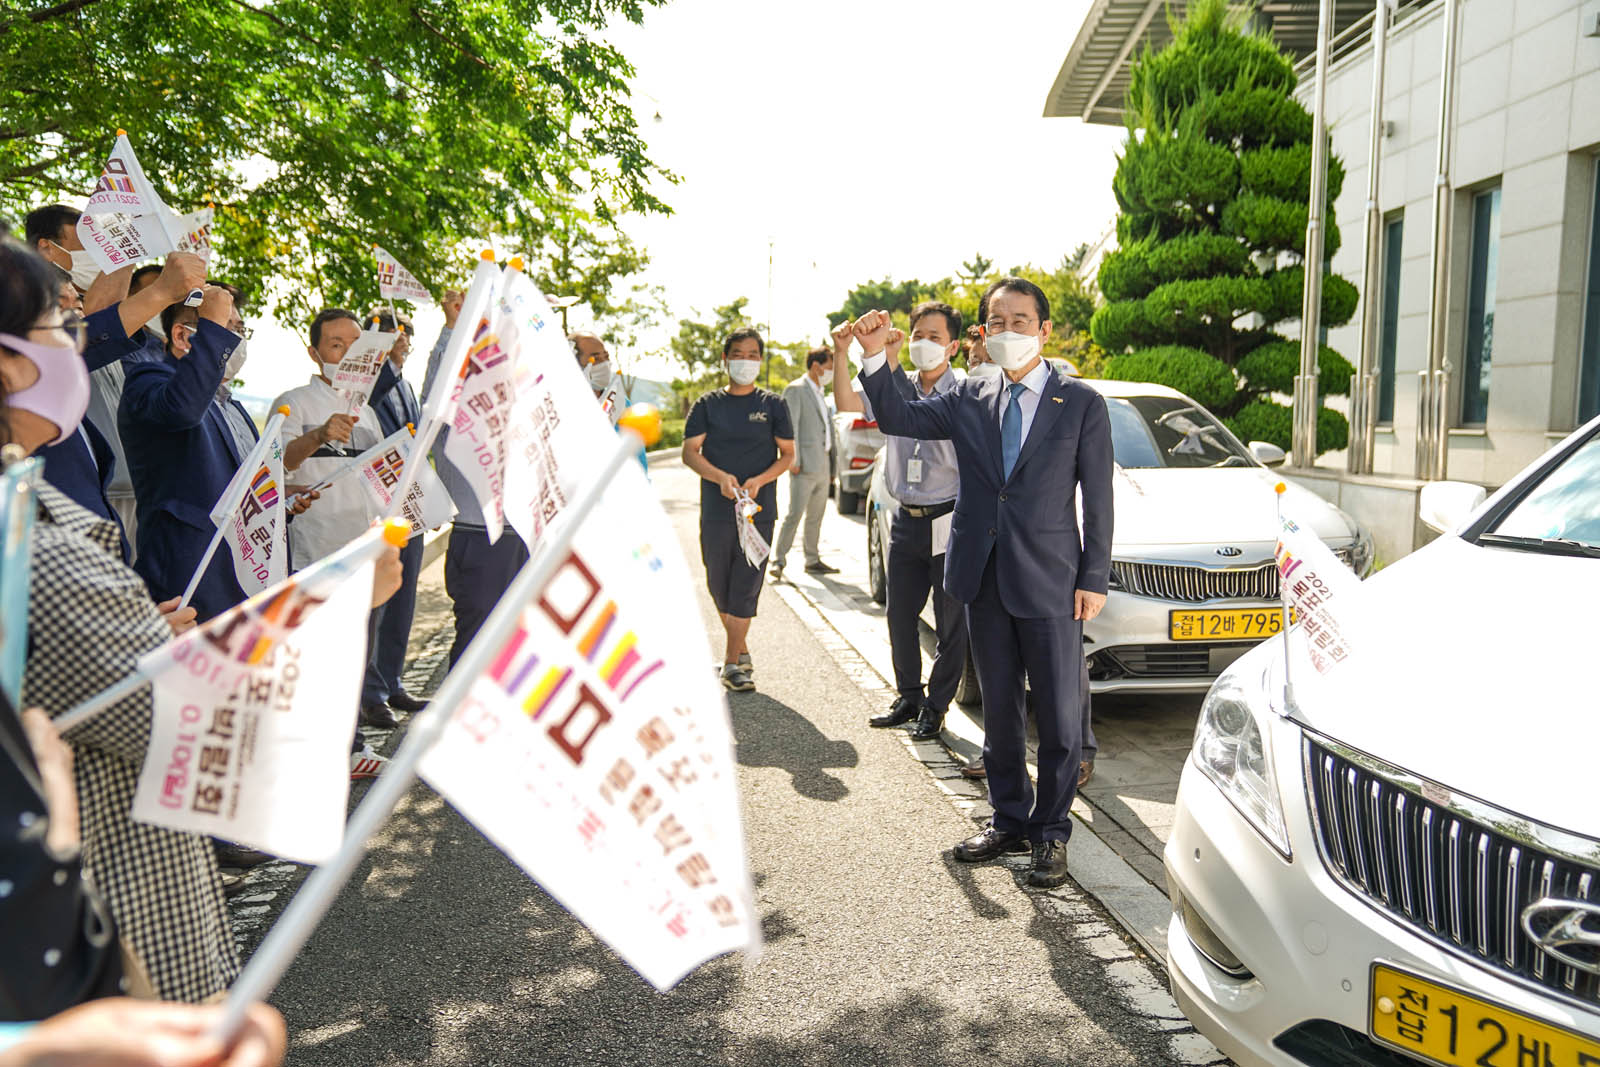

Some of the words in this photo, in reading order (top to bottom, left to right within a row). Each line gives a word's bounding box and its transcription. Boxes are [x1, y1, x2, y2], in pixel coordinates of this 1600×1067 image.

[1218, 547, 1241, 557] KIA
[1292, 580, 1324, 612] 목포
[1305, 571, 1333, 600] 2021
[1197, 614, 1236, 635] 12바
